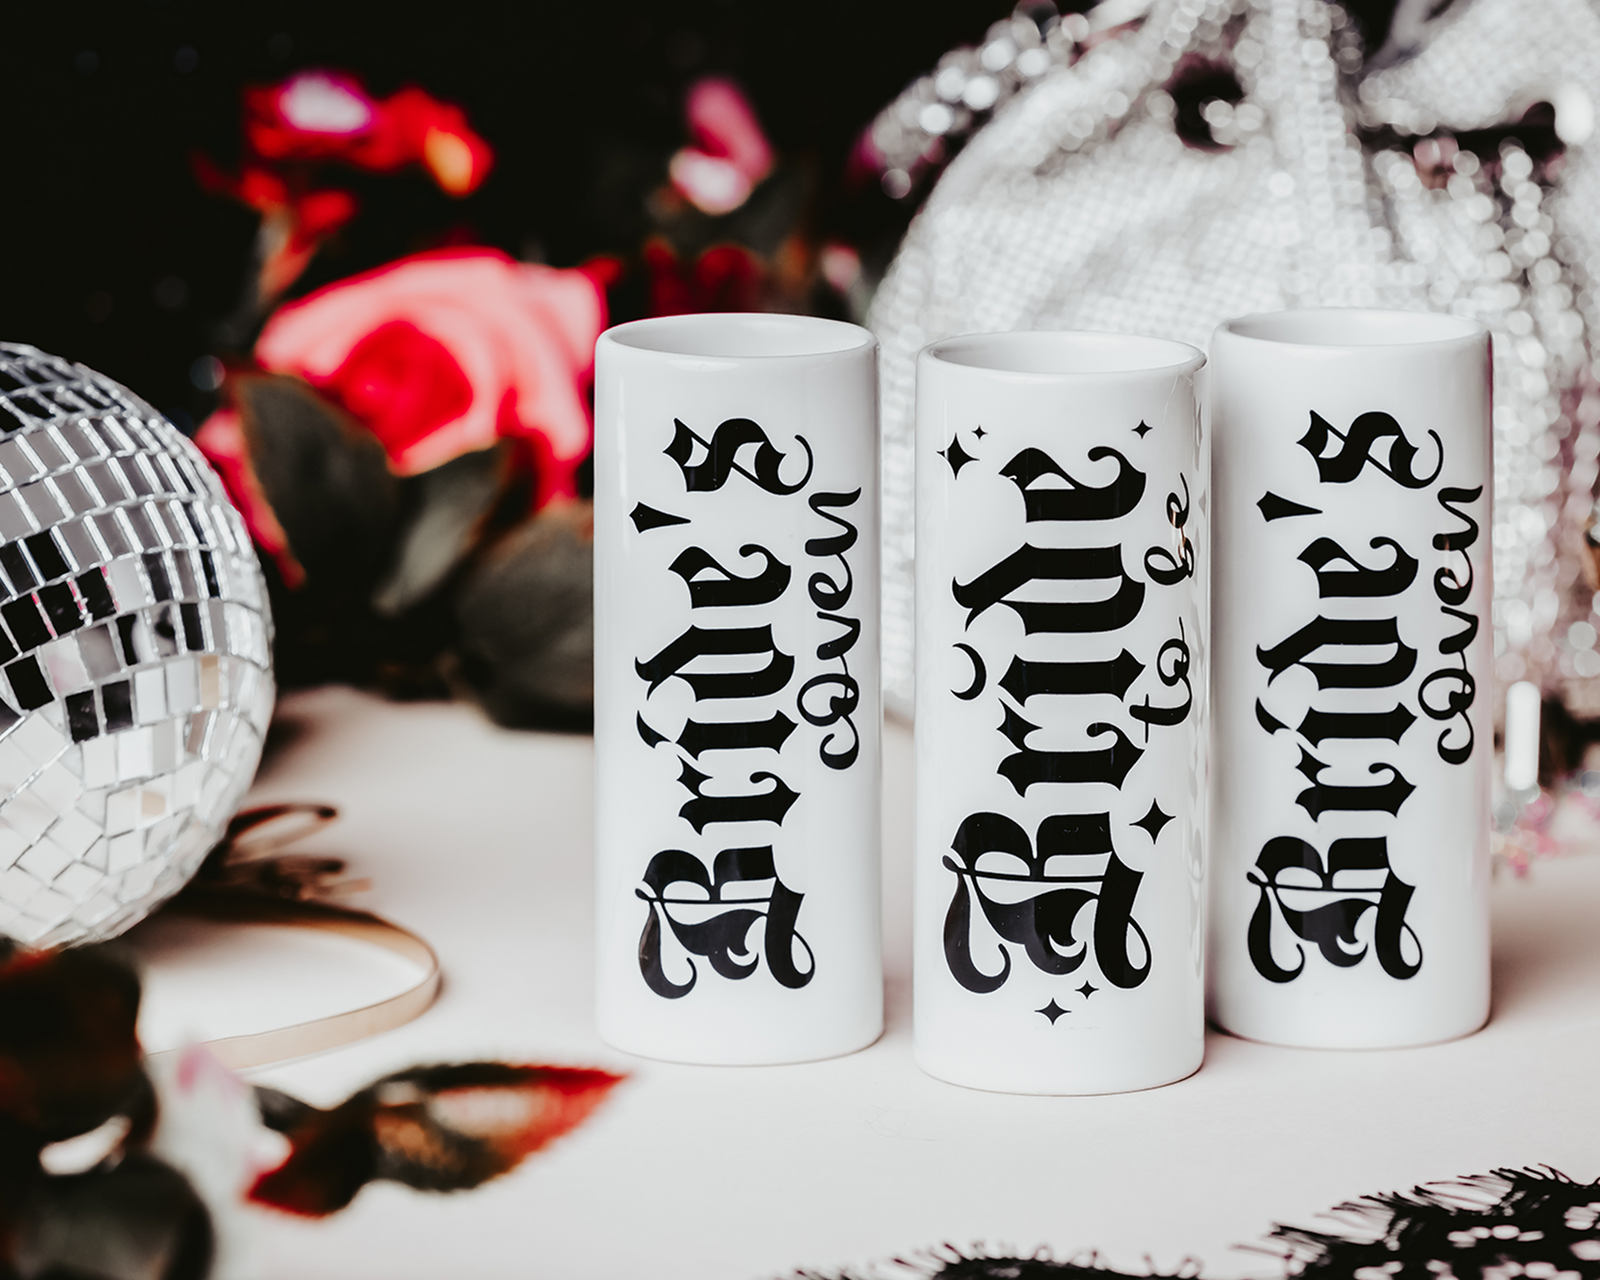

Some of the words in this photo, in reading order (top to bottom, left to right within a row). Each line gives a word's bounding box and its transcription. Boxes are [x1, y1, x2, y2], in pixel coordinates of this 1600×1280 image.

[796, 486, 862, 771] coven
[1143, 472, 1195, 586] be
[1417, 484, 1484, 766] coven
[629, 417, 816, 1000] Bride's
[942, 445, 1152, 994] Bride
[1128, 616, 1194, 744] to
[1246, 409, 1444, 984] Bride's
